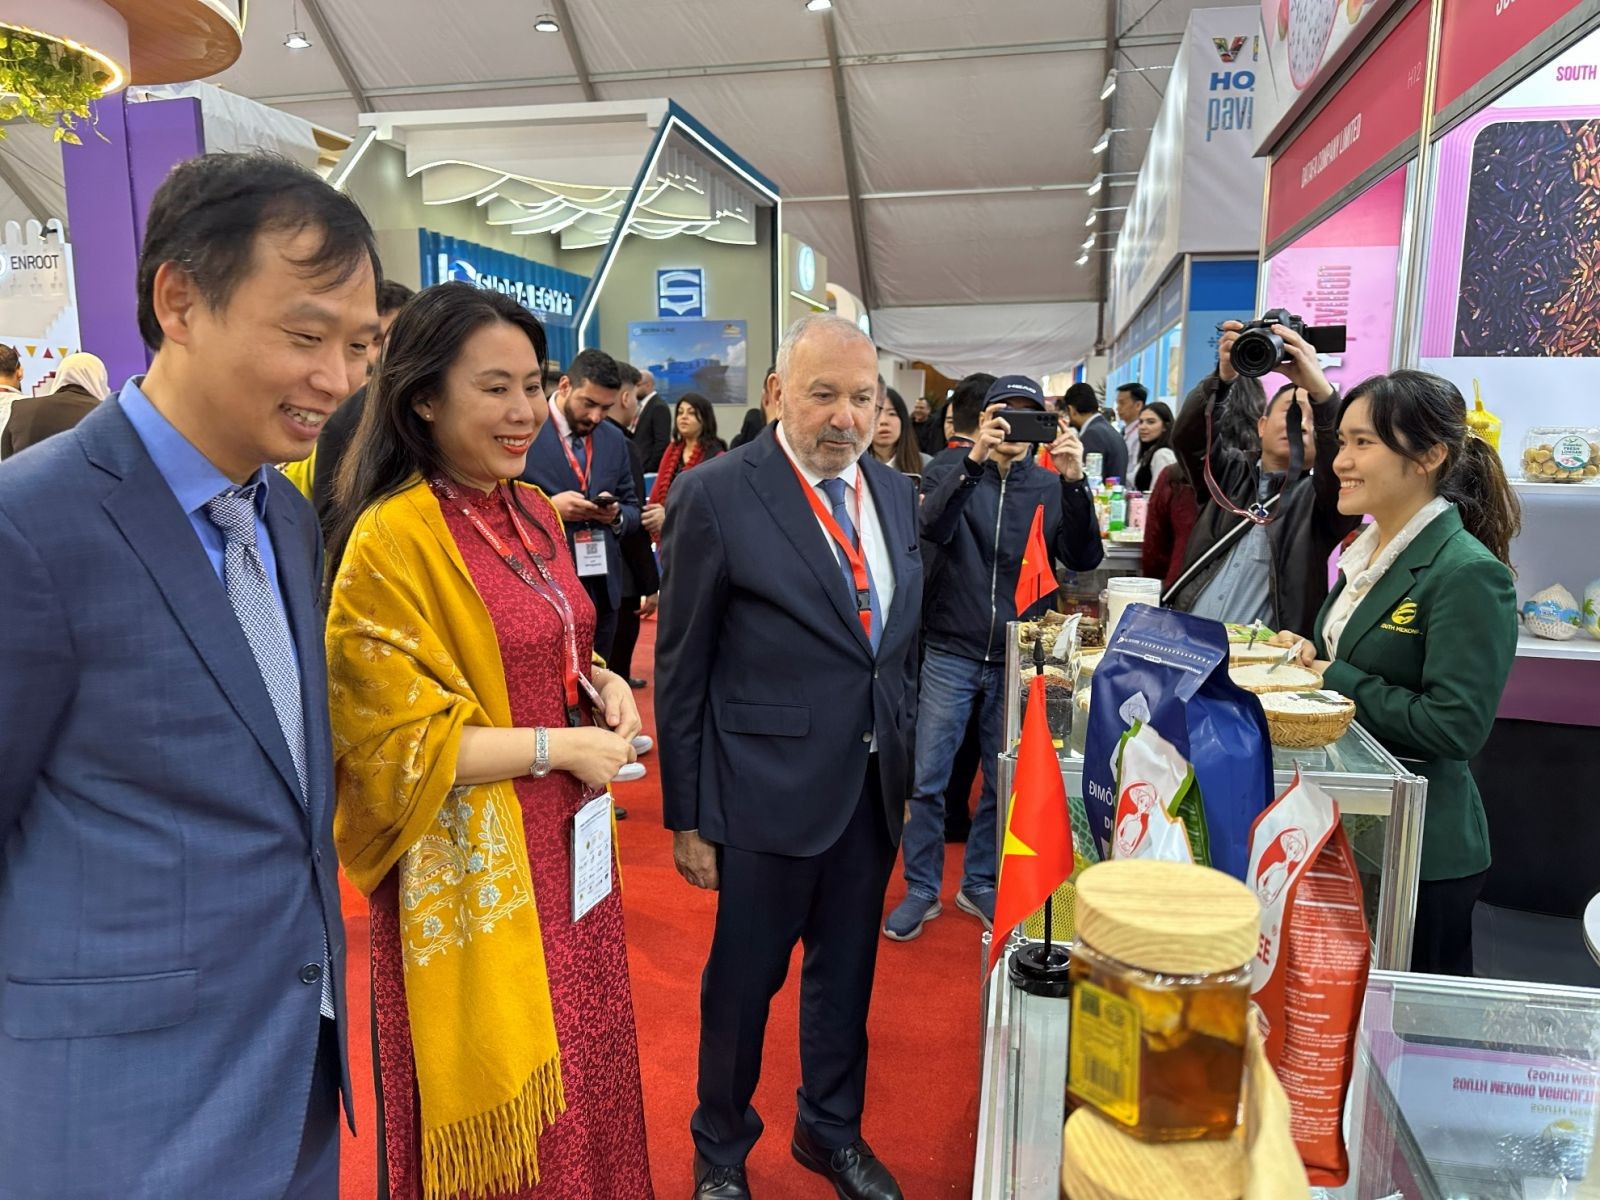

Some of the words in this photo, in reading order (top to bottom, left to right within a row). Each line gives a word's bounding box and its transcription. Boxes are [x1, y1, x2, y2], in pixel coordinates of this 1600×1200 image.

[1556, 64, 1597, 81] SOUTH
[1206, 87, 1255, 142] pavi
[10, 254, 59, 270] ENROOT
